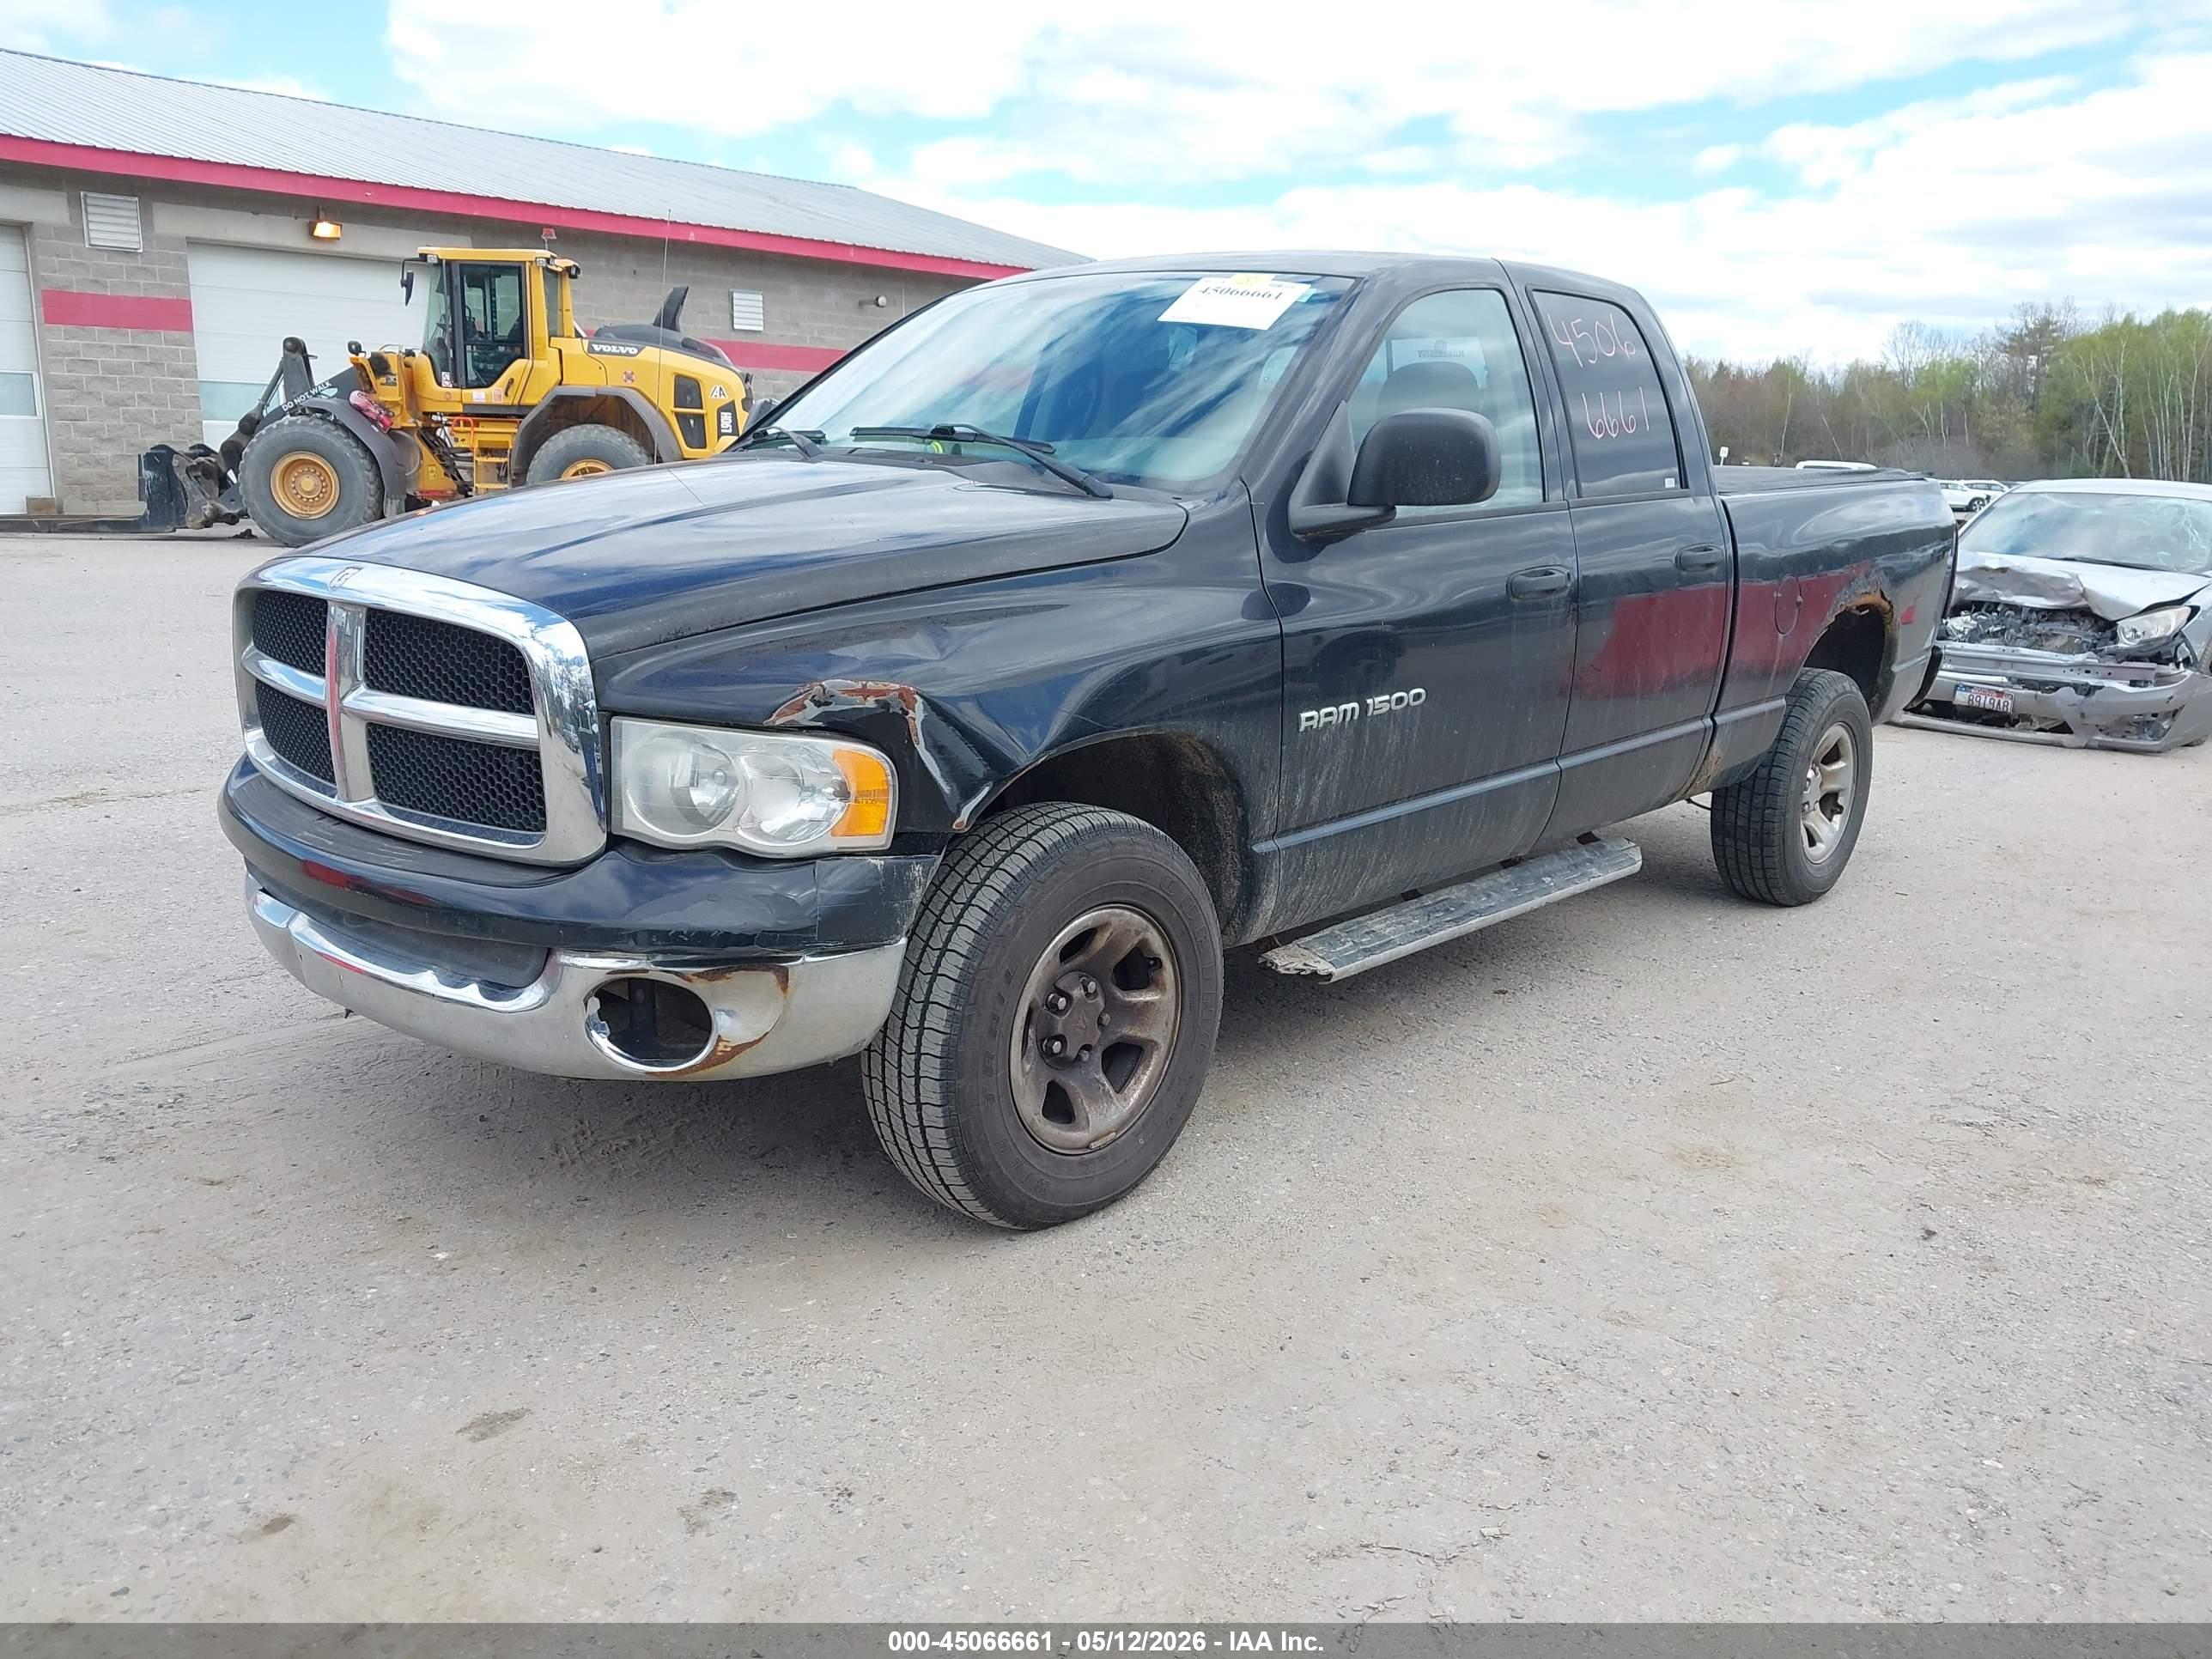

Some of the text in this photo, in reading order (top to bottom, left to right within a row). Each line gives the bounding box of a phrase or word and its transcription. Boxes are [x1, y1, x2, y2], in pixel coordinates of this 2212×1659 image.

[1198, 286, 1283, 300] 45066661
[592, 343, 638, 355] VOLVO
[1547, 313, 1635, 368] 4506
[282, 380, 332, 412] DO NOT WALK
[720, 412, 732, 433] L90H
[1582, 386, 1650, 440] 6661
[1298, 688, 1427, 732] RAM 1500
